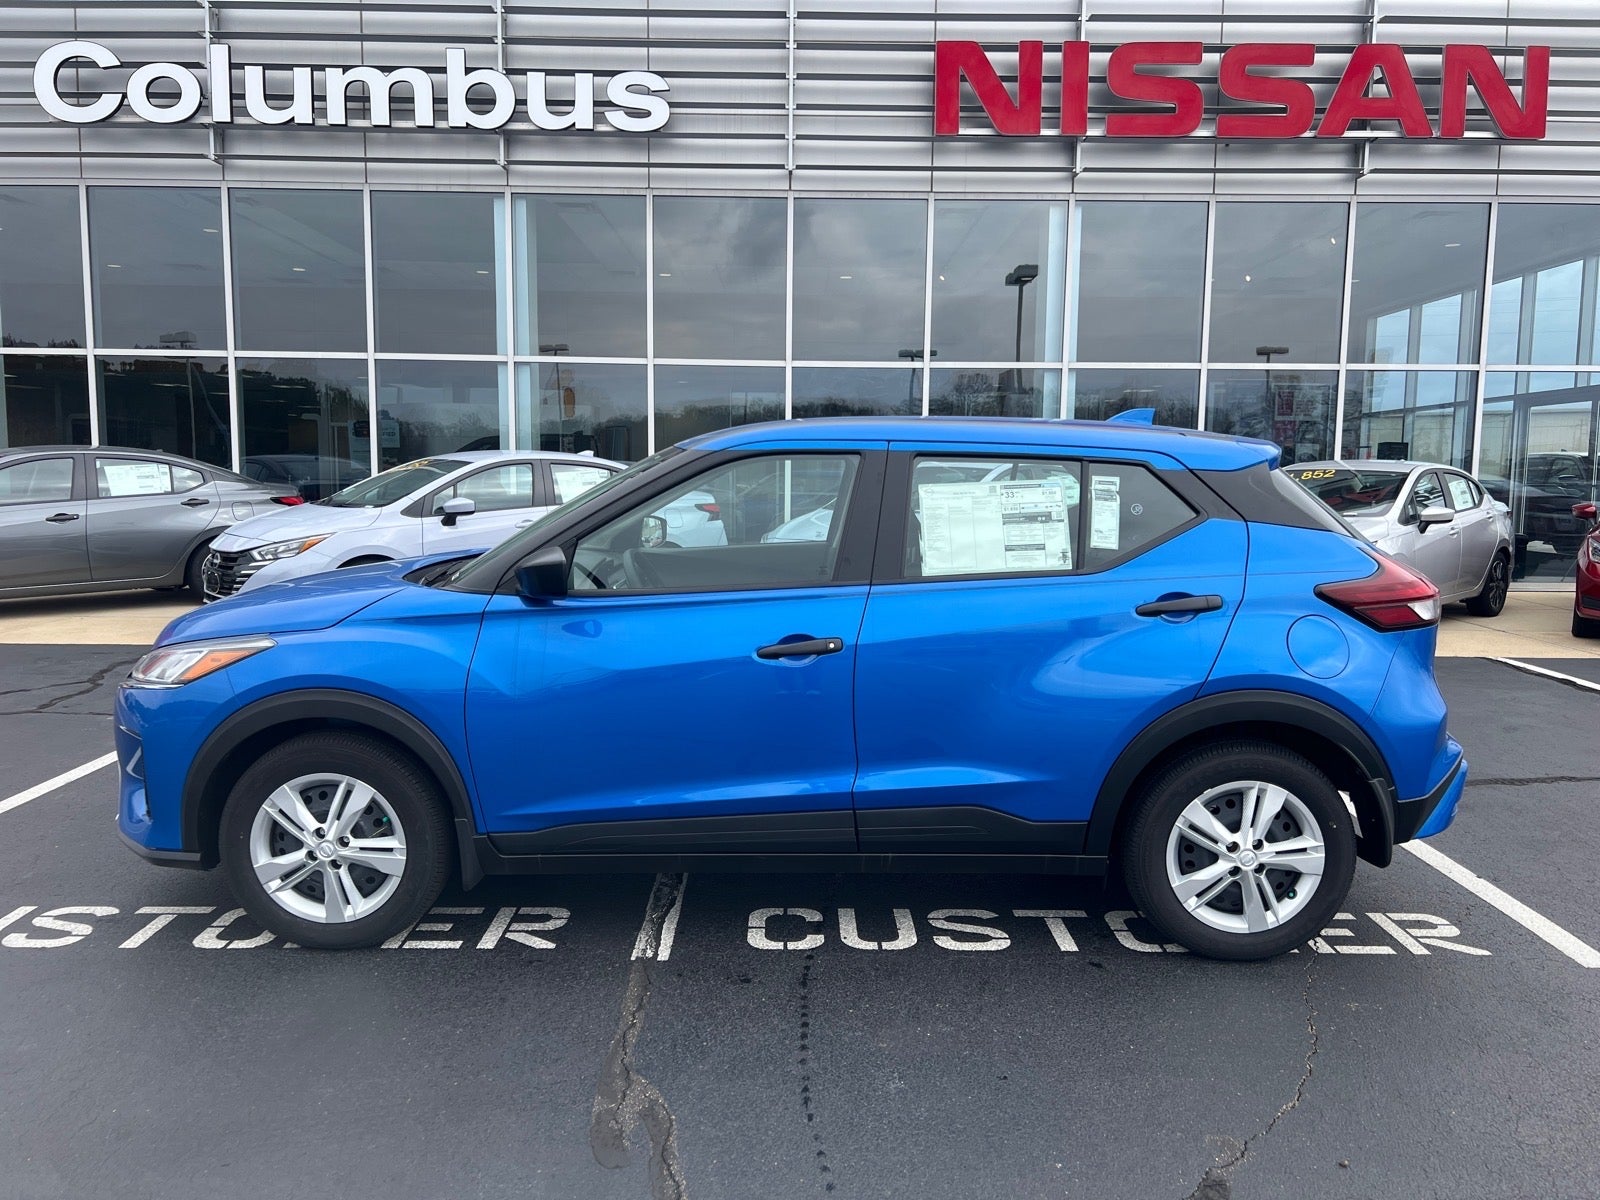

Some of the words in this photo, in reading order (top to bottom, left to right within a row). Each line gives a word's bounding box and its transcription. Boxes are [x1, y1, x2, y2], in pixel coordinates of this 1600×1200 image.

[33, 40, 671, 133] Columbus
[934, 40, 1550, 140] NISSAN
[1004, 491, 1015, 499] 33
[746, 907, 1493, 956] CUSTOER
